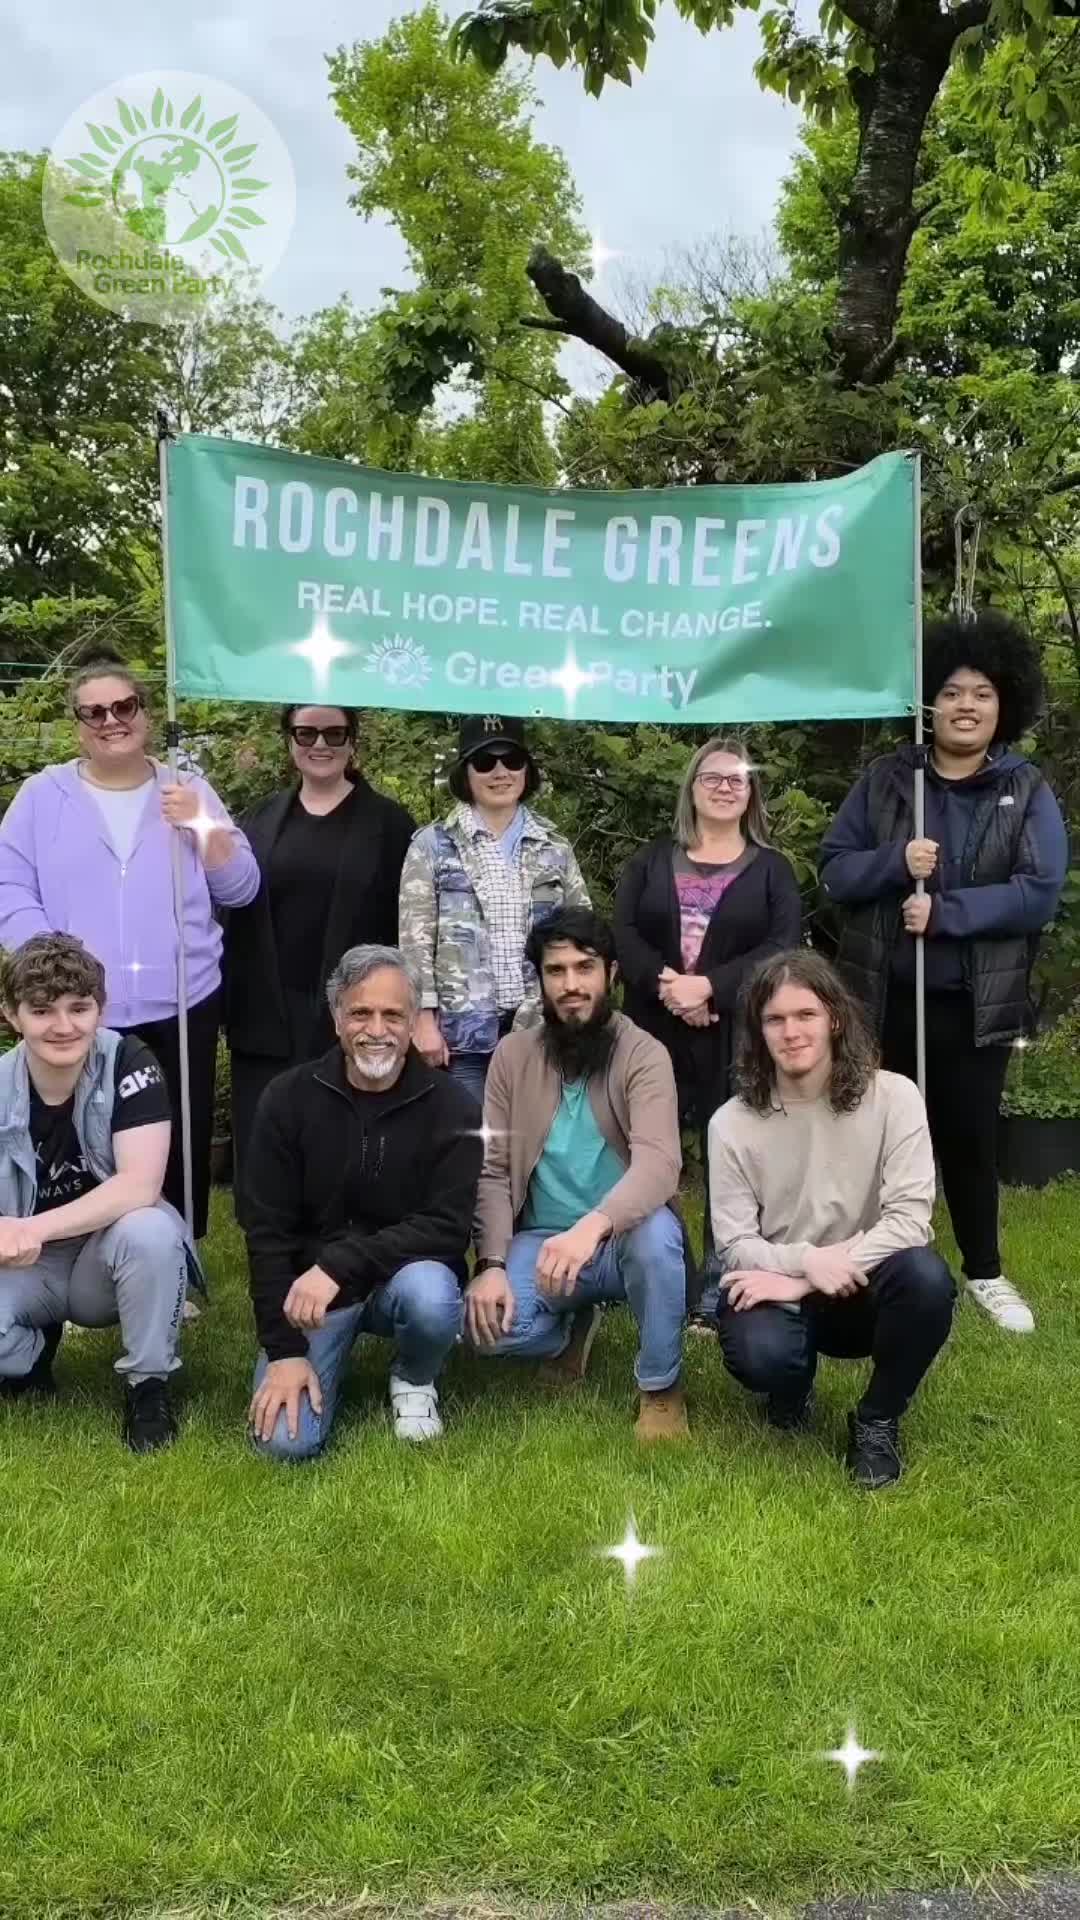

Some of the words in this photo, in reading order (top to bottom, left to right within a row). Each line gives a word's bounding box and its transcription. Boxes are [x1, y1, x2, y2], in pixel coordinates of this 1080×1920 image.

[232, 476, 576, 578] ROCHDALE
[603, 504, 843, 586] GREENS
[298, 581, 391, 617] REAL
[403, 592, 507, 627] HOPE.
[518, 602, 608, 636] REAL
[620, 601, 773, 639] CHANGE.
[445, 651, 573, 691] Gree
[588, 660, 698, 711] Party
